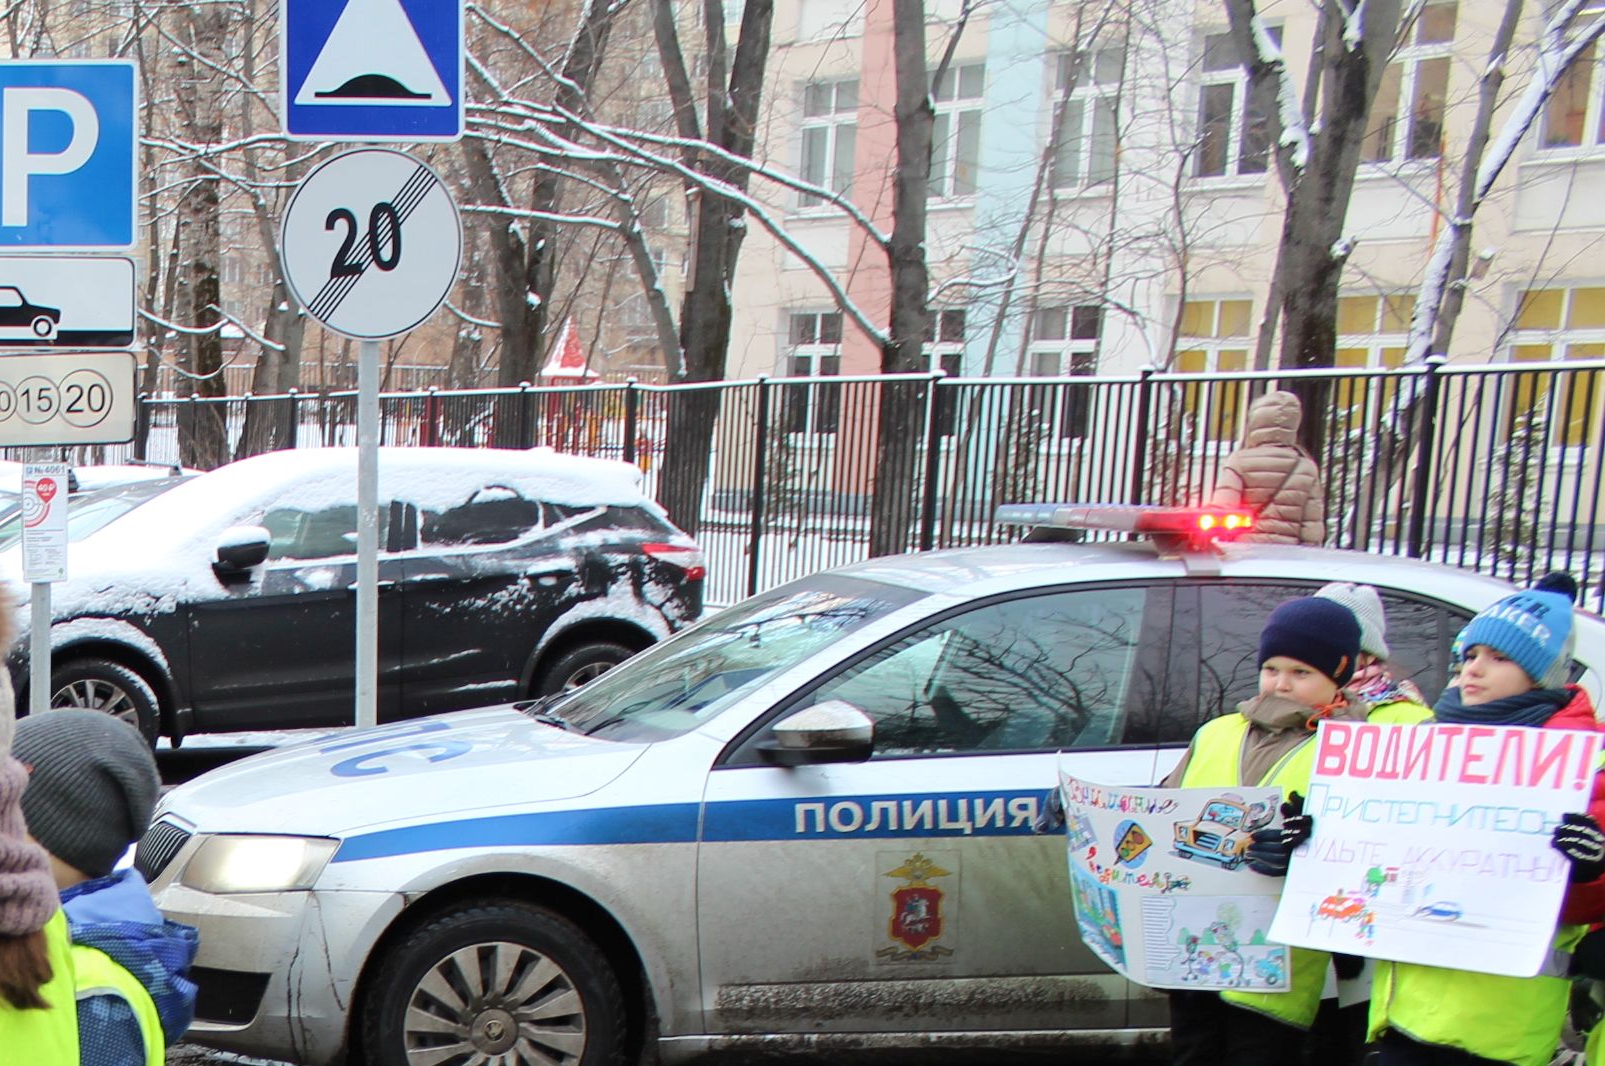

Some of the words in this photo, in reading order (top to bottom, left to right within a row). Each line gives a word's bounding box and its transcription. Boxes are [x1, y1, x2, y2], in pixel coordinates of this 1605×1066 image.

[2, 87, 99, 227] P
[324, 202, 402, 279] 20
[1315, 723, 1597, 791] ВОДИТЕЛИ!
[795, 796, 1038, 835] ПОЛИЦИЯ
